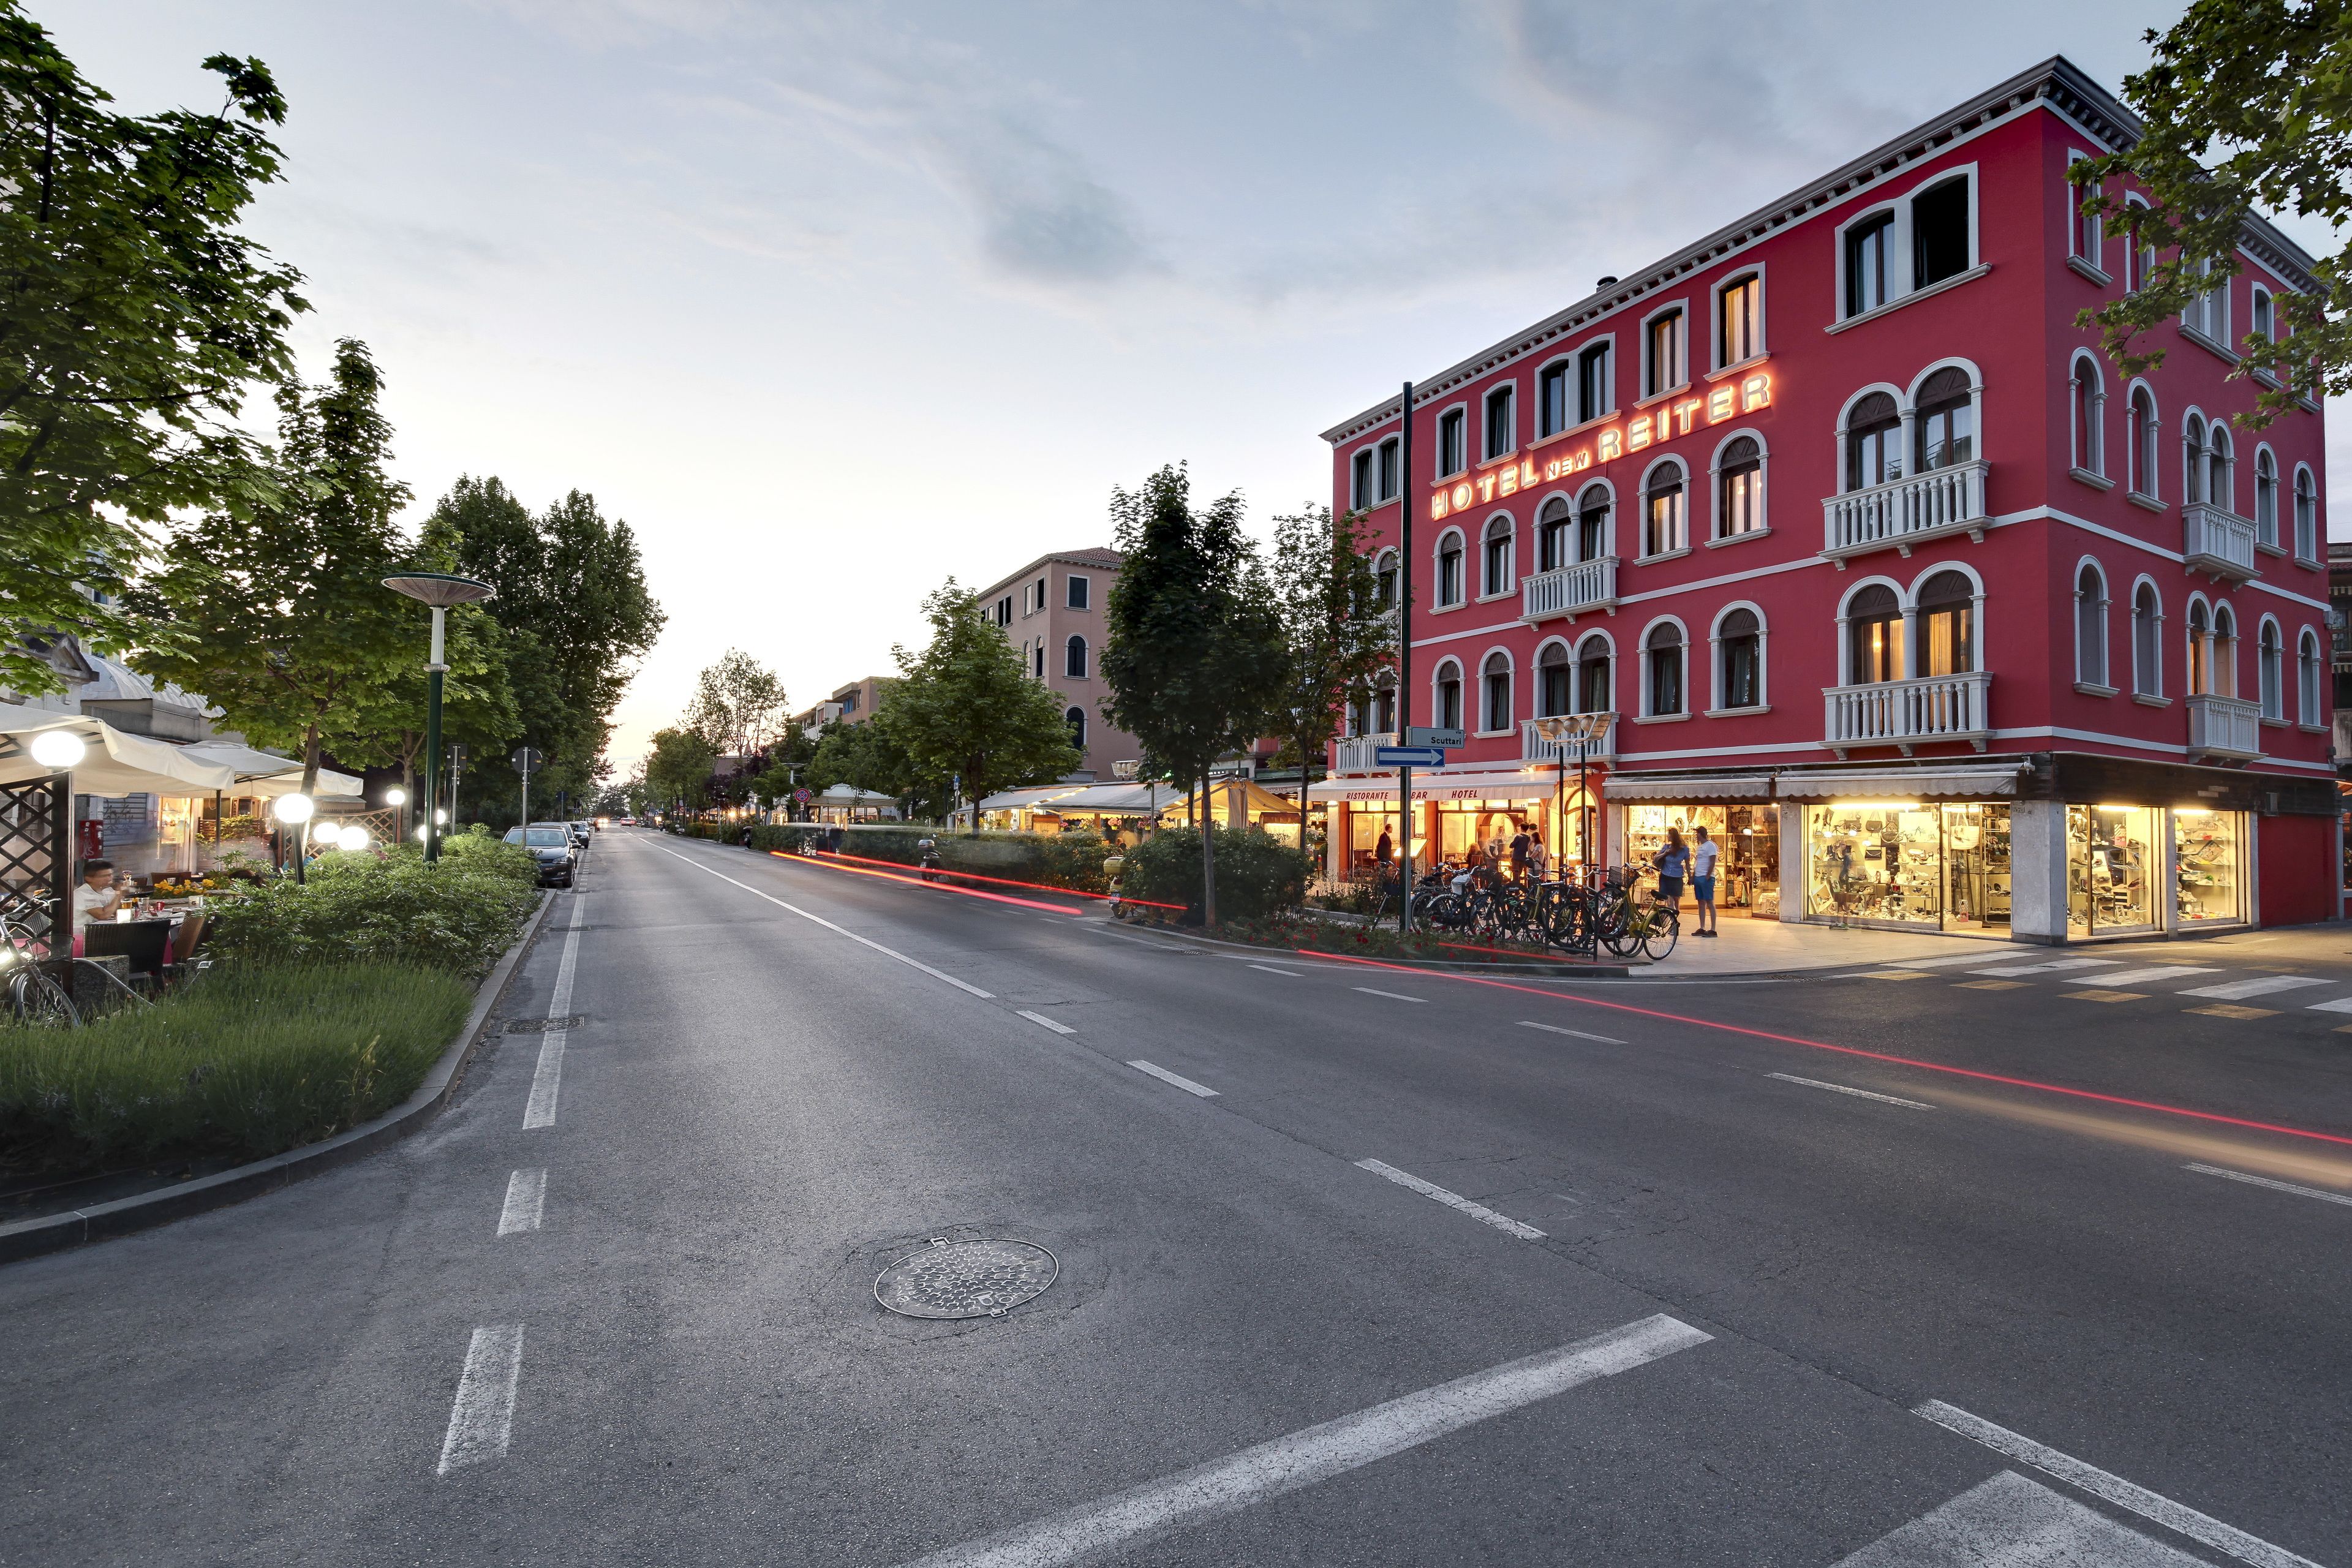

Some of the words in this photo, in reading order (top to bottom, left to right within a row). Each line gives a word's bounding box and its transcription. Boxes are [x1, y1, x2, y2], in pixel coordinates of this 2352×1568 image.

[1432, 462, 1536, 518] HOTEL
[1548, 453, 1586, 478] NEW
[1598, 375, 1770, 461] REITER
